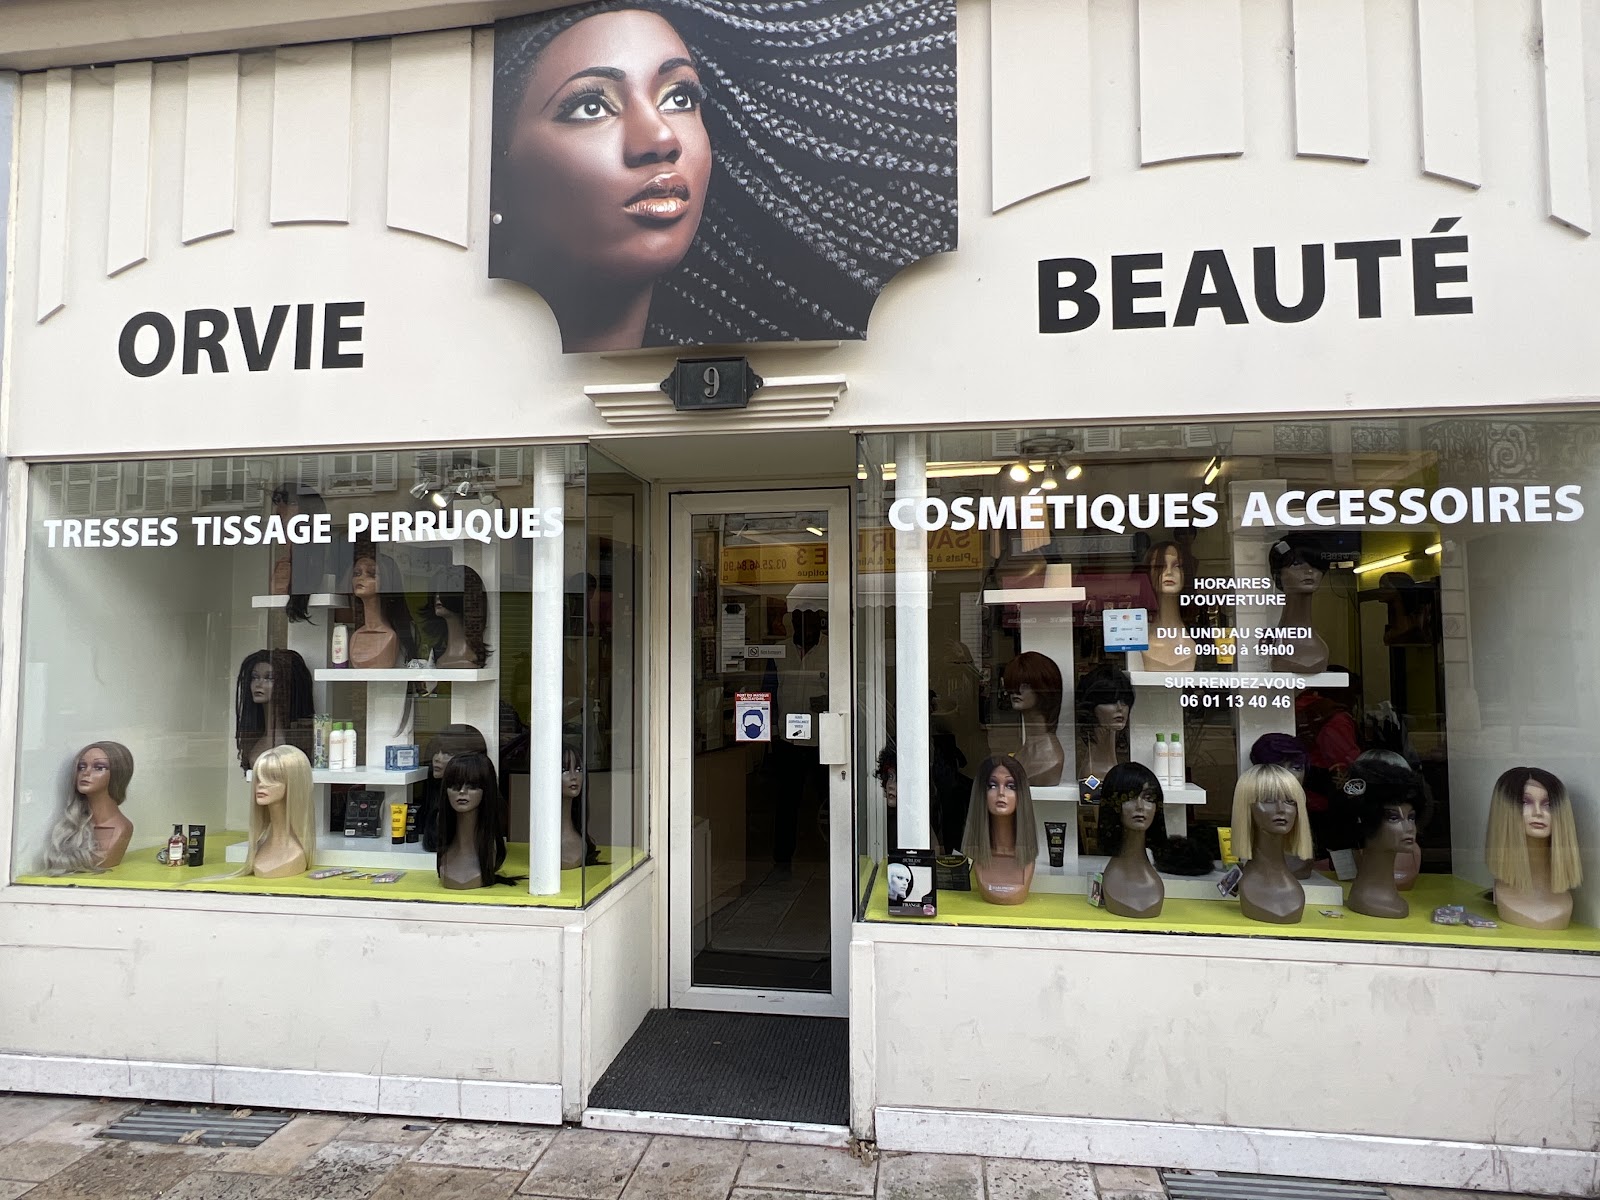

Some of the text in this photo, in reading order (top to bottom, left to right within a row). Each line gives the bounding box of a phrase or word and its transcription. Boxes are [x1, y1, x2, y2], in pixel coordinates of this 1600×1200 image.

[1038, 216, 1474, 334] BEAUTÉ
[118, 301, 366, 378] ORVIE
[703, 366, 720, 398] 9
[887, 484, 1584, 535] COSMÉTIQUES ACCESSOIRES
[43, 506, 564, 549] TRESSES TISSAGE PERRUQUES
[1194, 577, 1271, 590] HORAIRES
[1156, 627, 1312, 639] DU LUNDI AU SAMEDI
[1174, 644, 1294, 656] de 09h30 à 19h00
[1165, 677, 1306, 690] SUR RENDEZ-VOUS
[1180, 695, 1291, 708] 06 01 13 40 46
